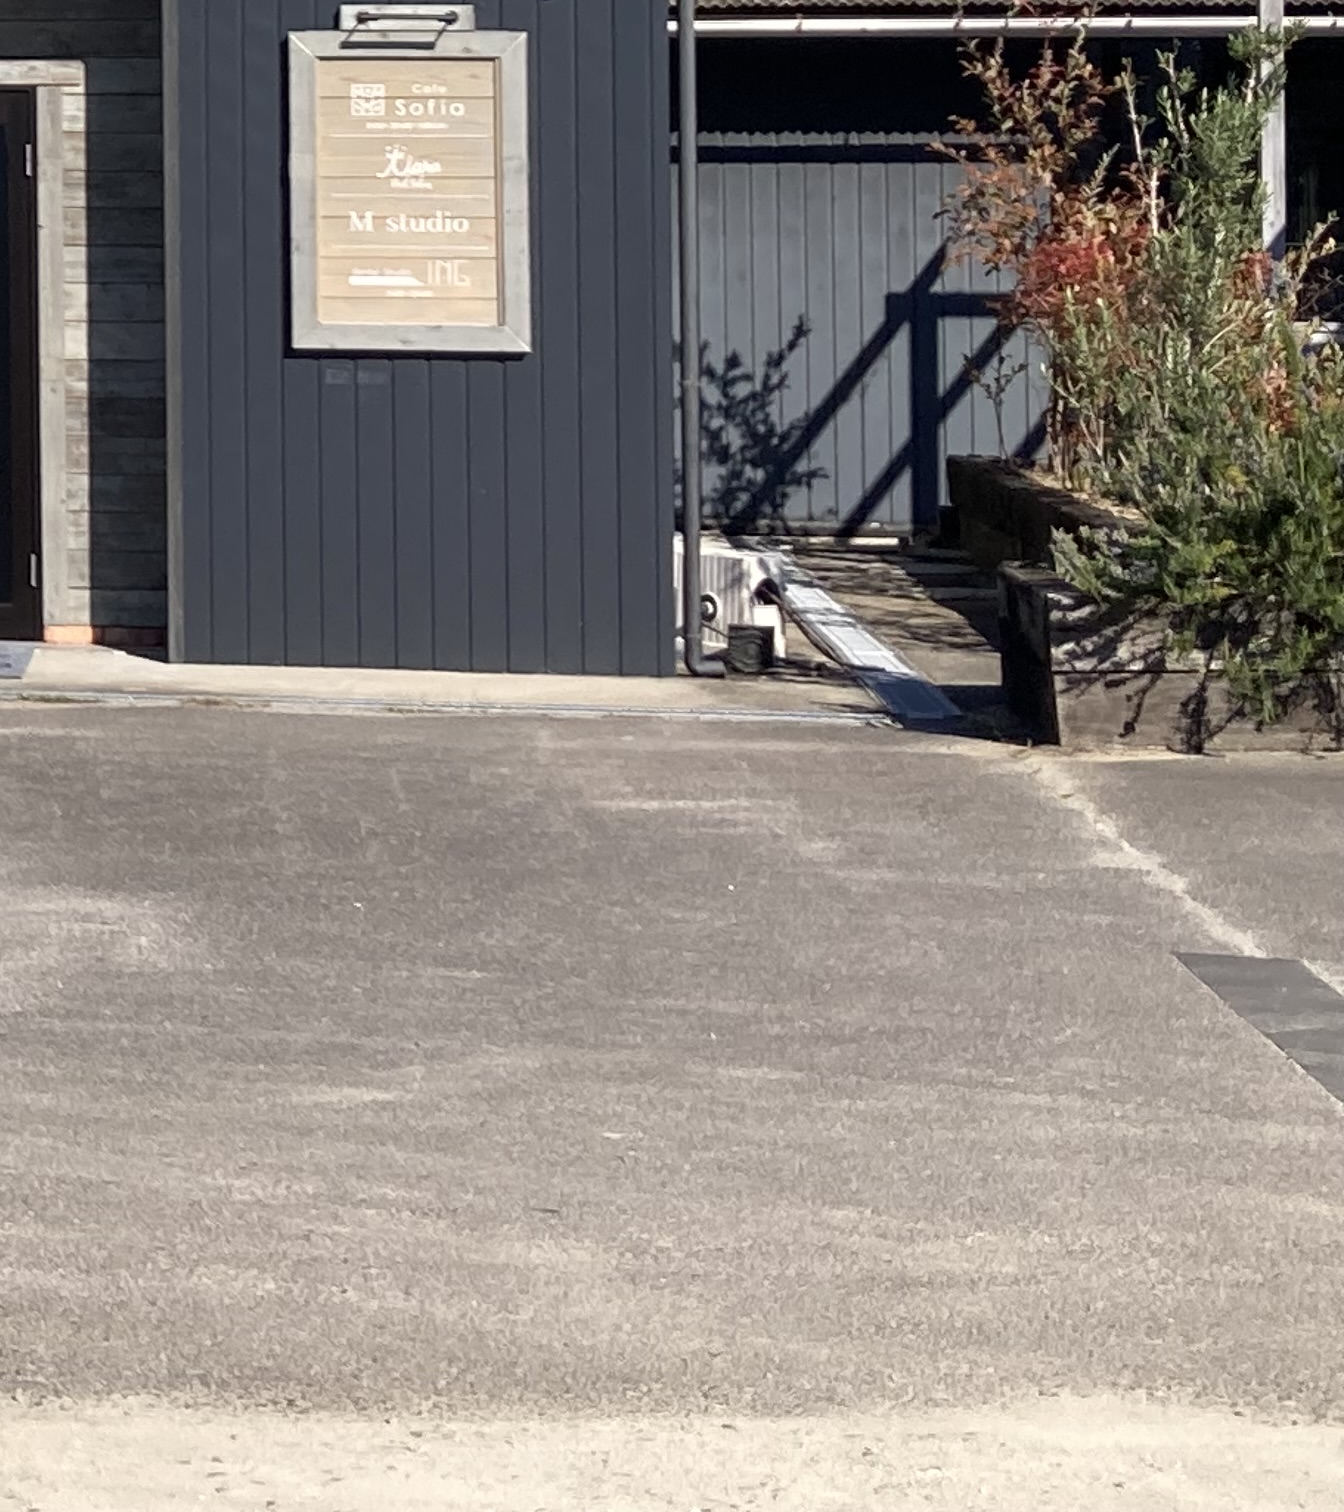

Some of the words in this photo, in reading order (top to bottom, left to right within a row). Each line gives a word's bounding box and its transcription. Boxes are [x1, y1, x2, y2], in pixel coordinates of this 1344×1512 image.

[394, 98, 466, 117] Sofia
[348, 210, 375, 233] M
[385, 209, 470, 233] studio
